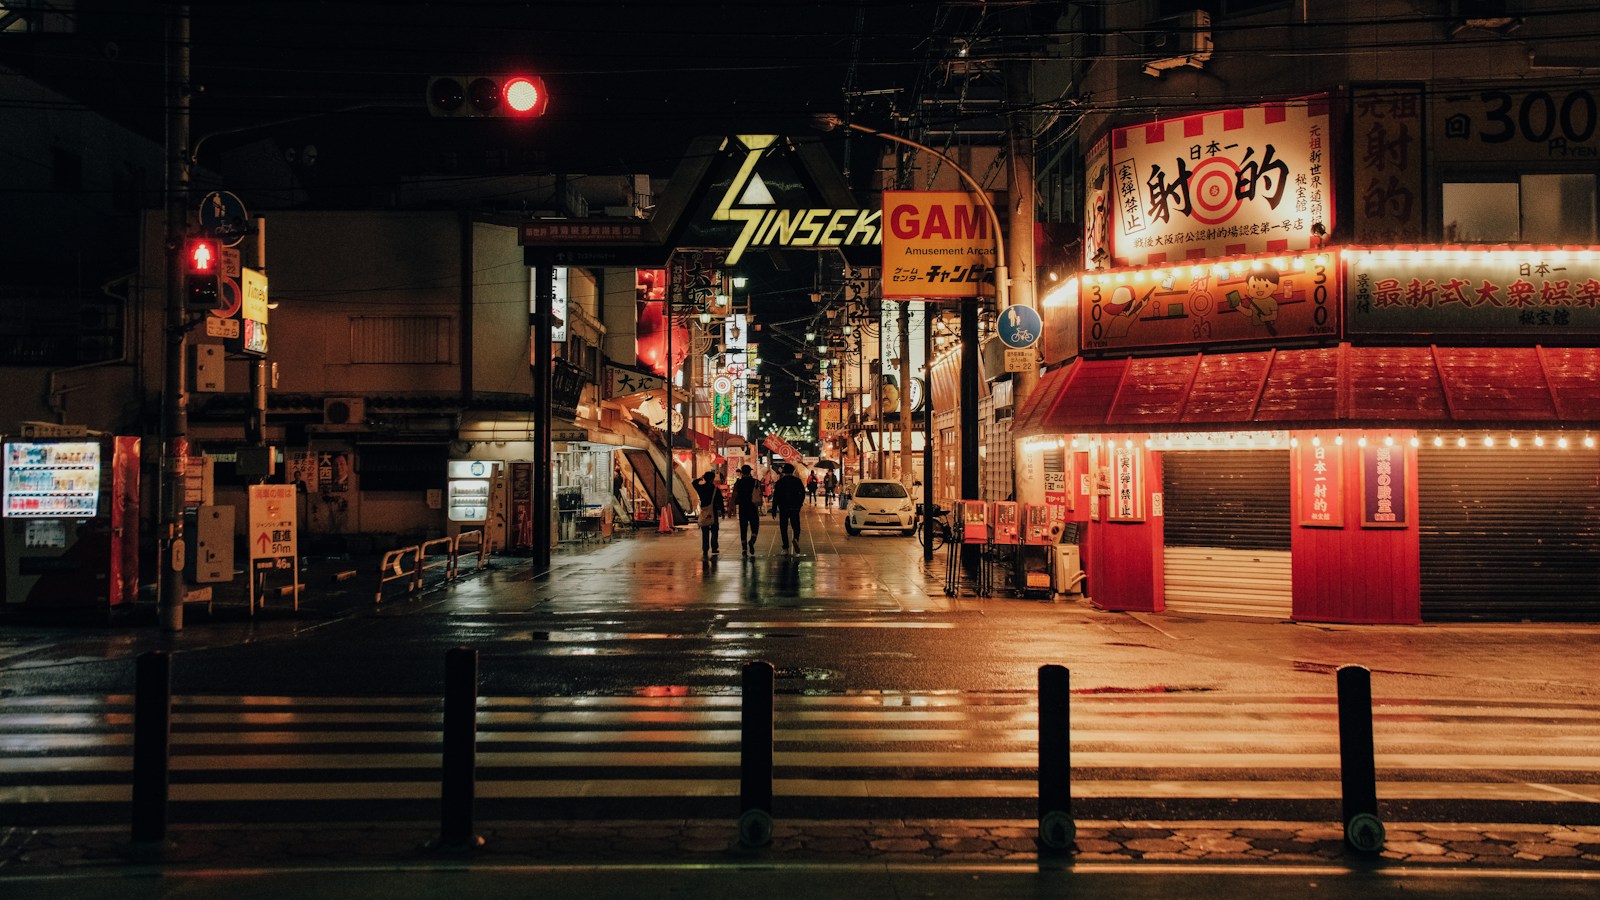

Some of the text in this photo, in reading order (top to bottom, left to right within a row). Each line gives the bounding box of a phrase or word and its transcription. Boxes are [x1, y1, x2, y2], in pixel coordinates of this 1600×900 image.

[1480, 89, 1597, 143] 300
[1189, 140, 1239, 160] 日本一
[1363, 122, 1413, 223] 射的
[1118, 165, 1142, 231] 実弾禁止
[1146, 143, 1289, 226] 射的
[894, 267, 918, 275] ゲーム
[905, 246, 996, 256] Amusement Arcad
[1519, 261, 1567, 278] 日本一
[1091, 285, 1102, 340] 300
[1120, 457, 1131, 516] 実弾禁止
[1313, 447, 1327, 512] 日本一射的
[272, 530, 291, 542] 直進
[272, 543, 291, 554] 50m
